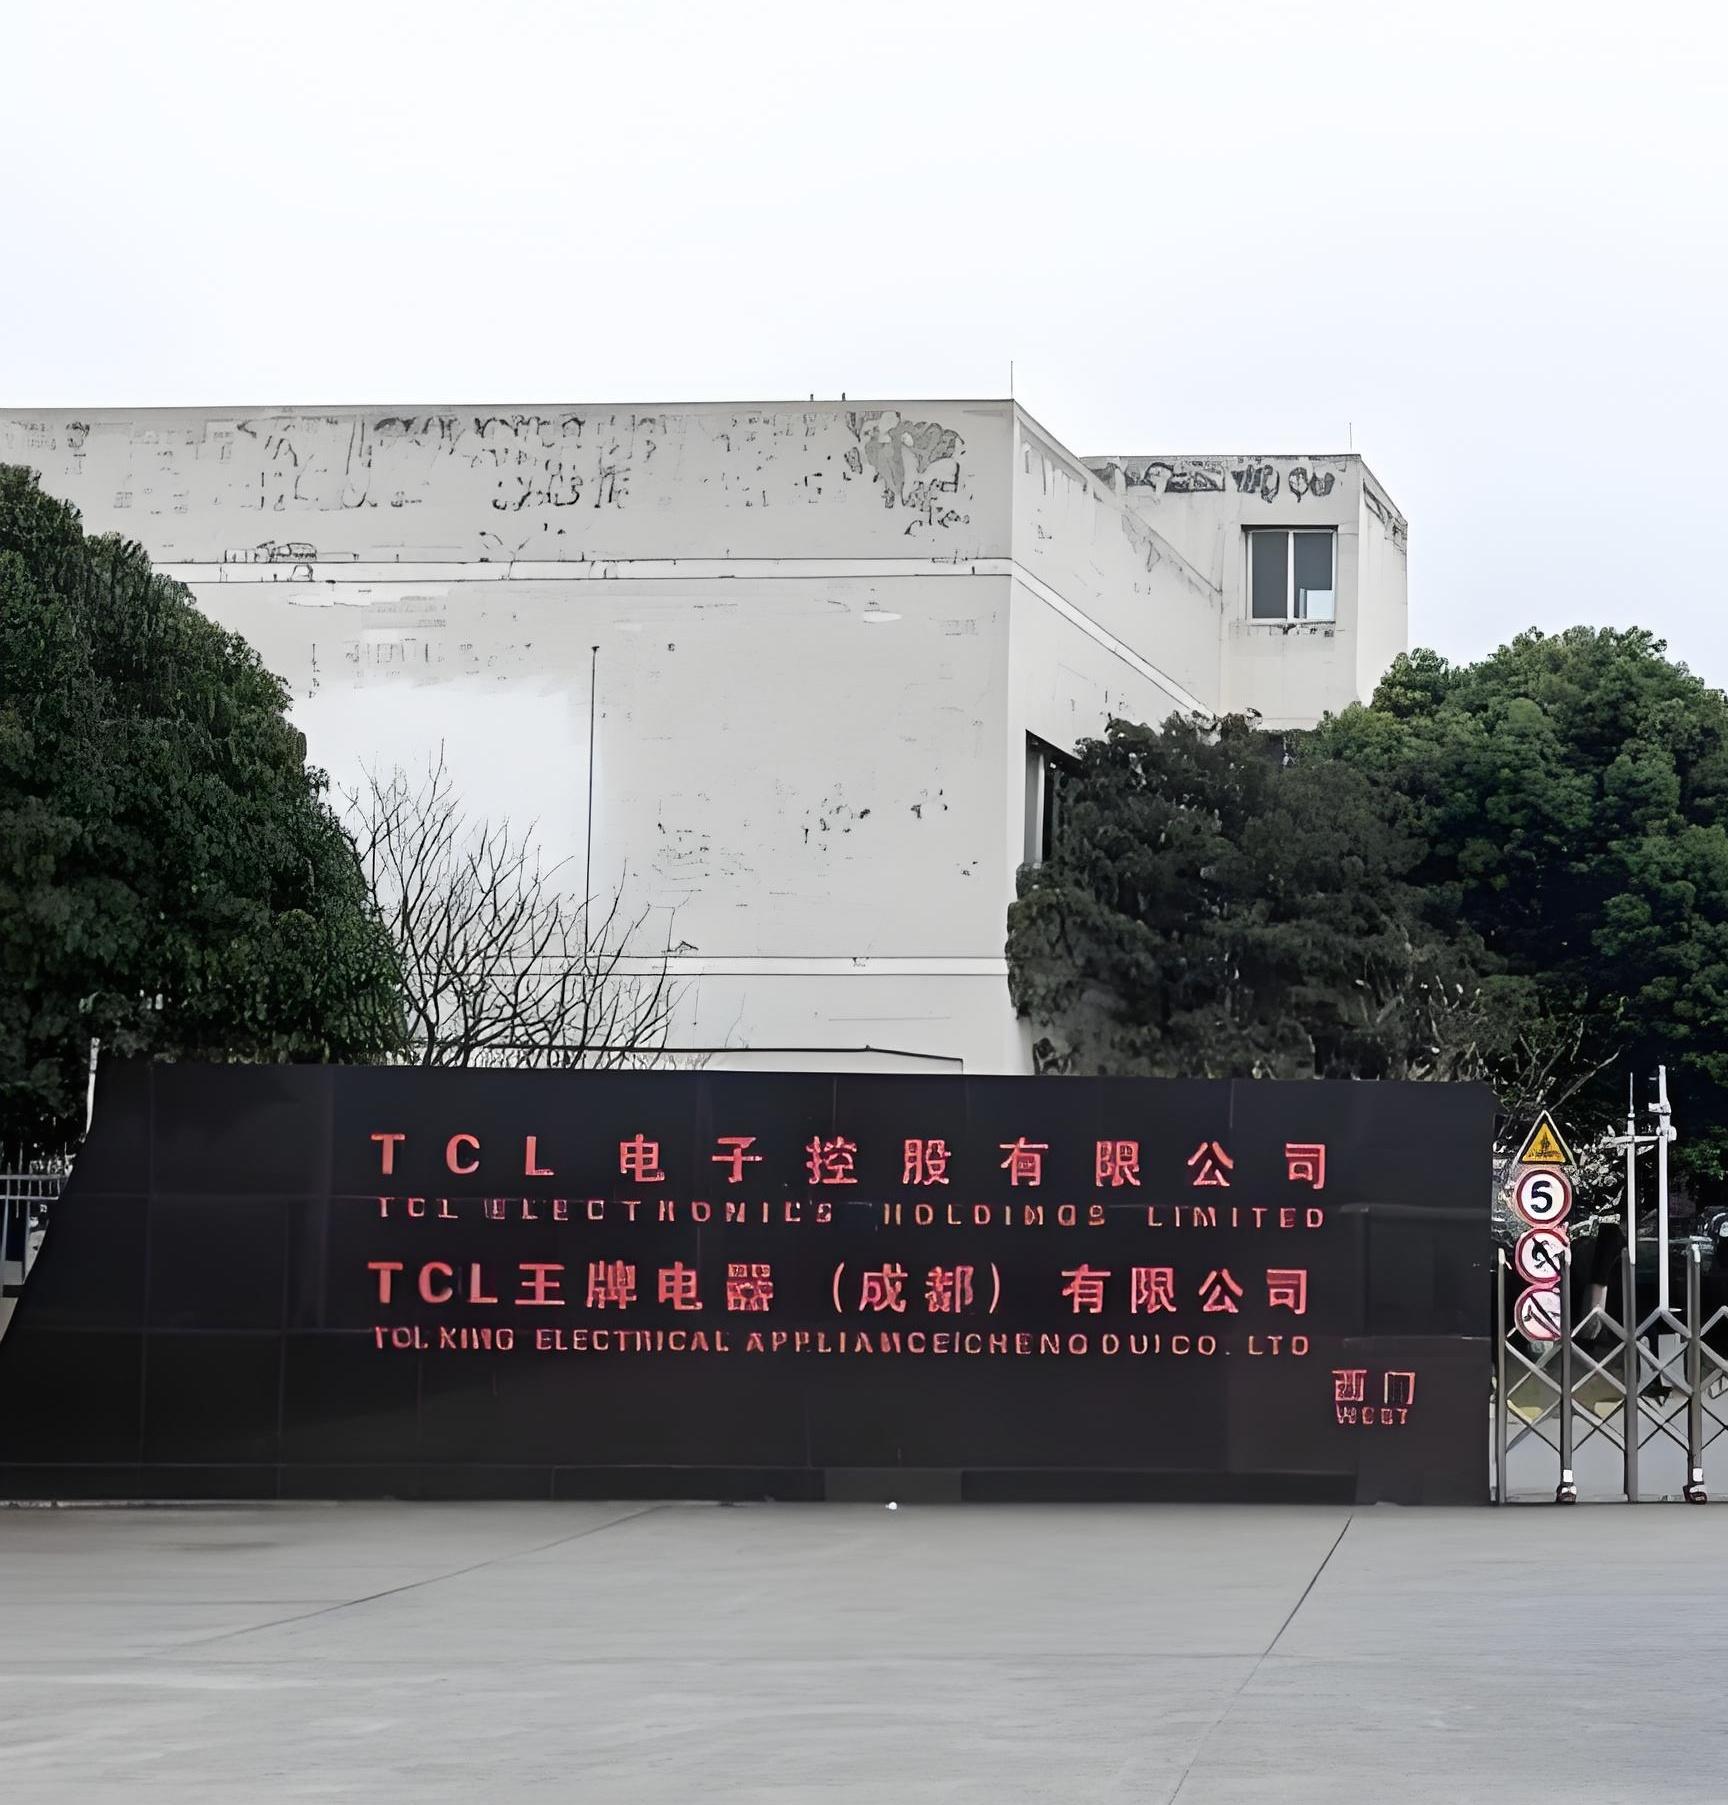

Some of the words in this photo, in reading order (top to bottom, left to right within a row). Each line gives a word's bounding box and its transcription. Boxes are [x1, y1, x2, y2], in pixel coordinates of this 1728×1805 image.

[370, 1133, 555, 1176] TCL
[619, 1134, 1326, 1190] 电子控股有限公司
[1531, 1180, 1553, 1214] 5
[1147, 1205, 1324, 1229] LIMITED
